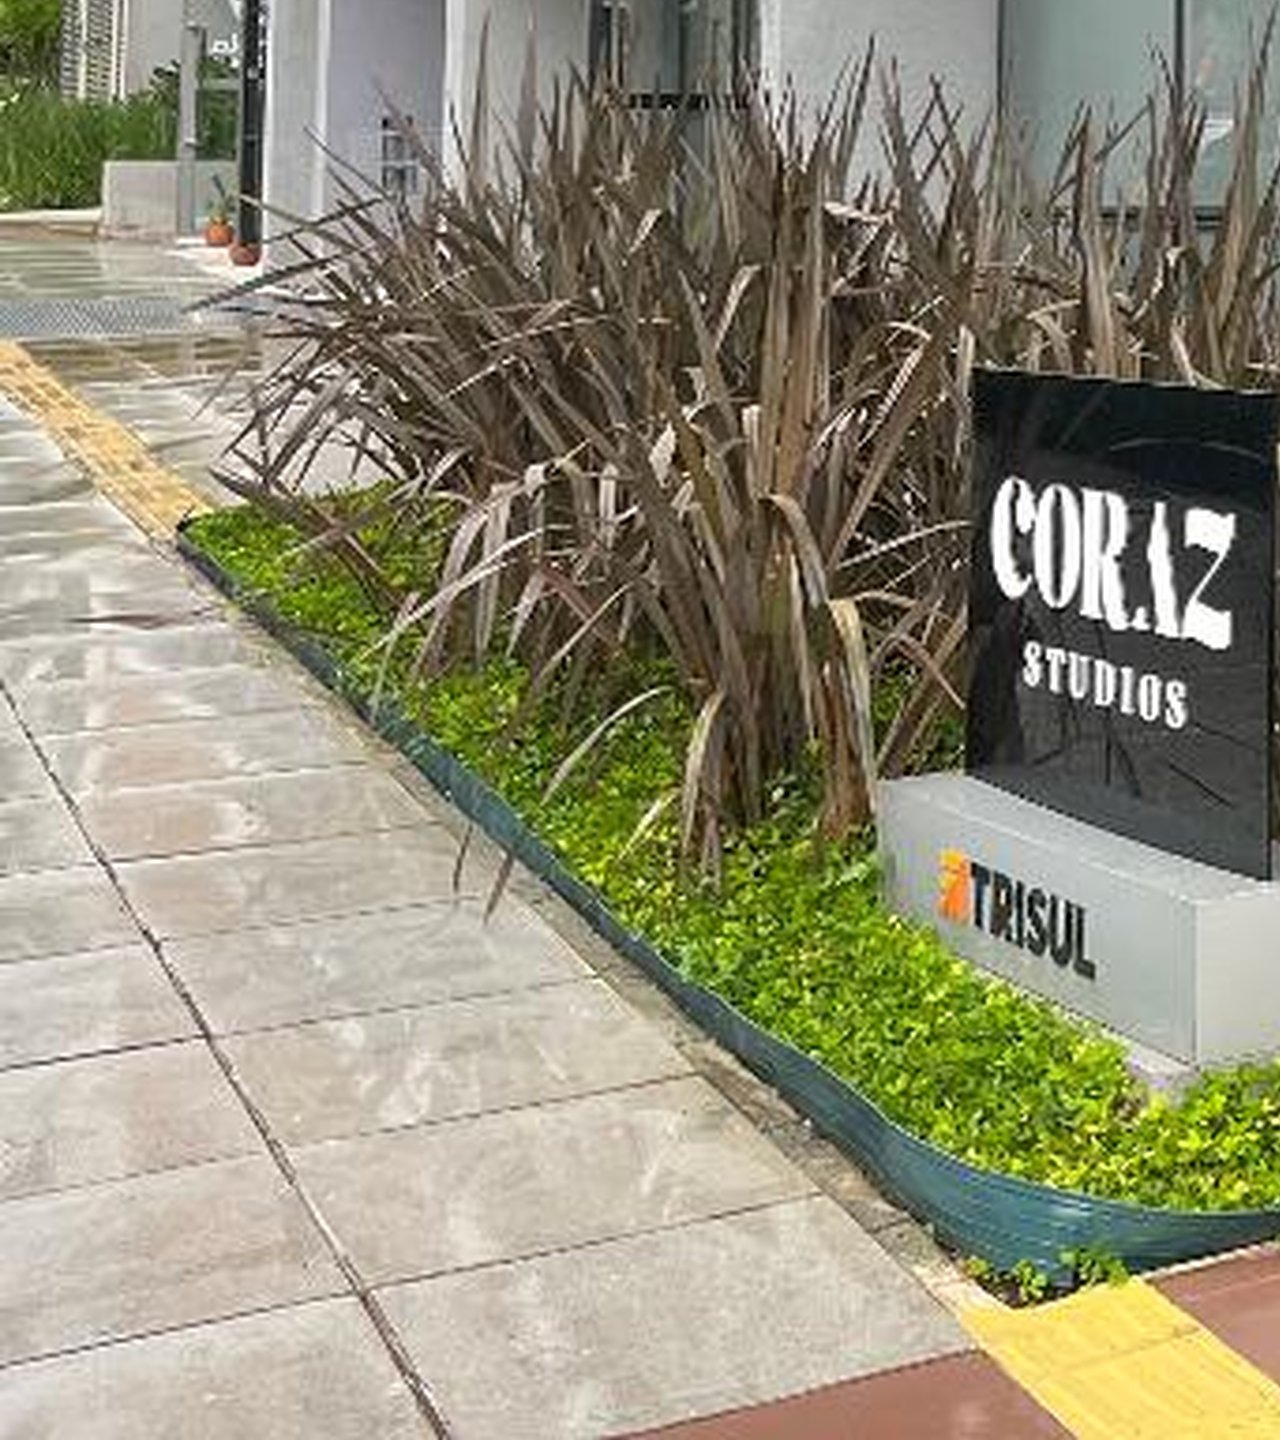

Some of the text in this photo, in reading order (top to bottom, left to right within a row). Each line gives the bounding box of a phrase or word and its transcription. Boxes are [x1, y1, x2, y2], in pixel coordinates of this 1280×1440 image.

[991, 474, 1235, 650] CORAZ
[1023, 640, 1186, 728] STUDIOS
[970, 861, 1096, 981] TRISUL
